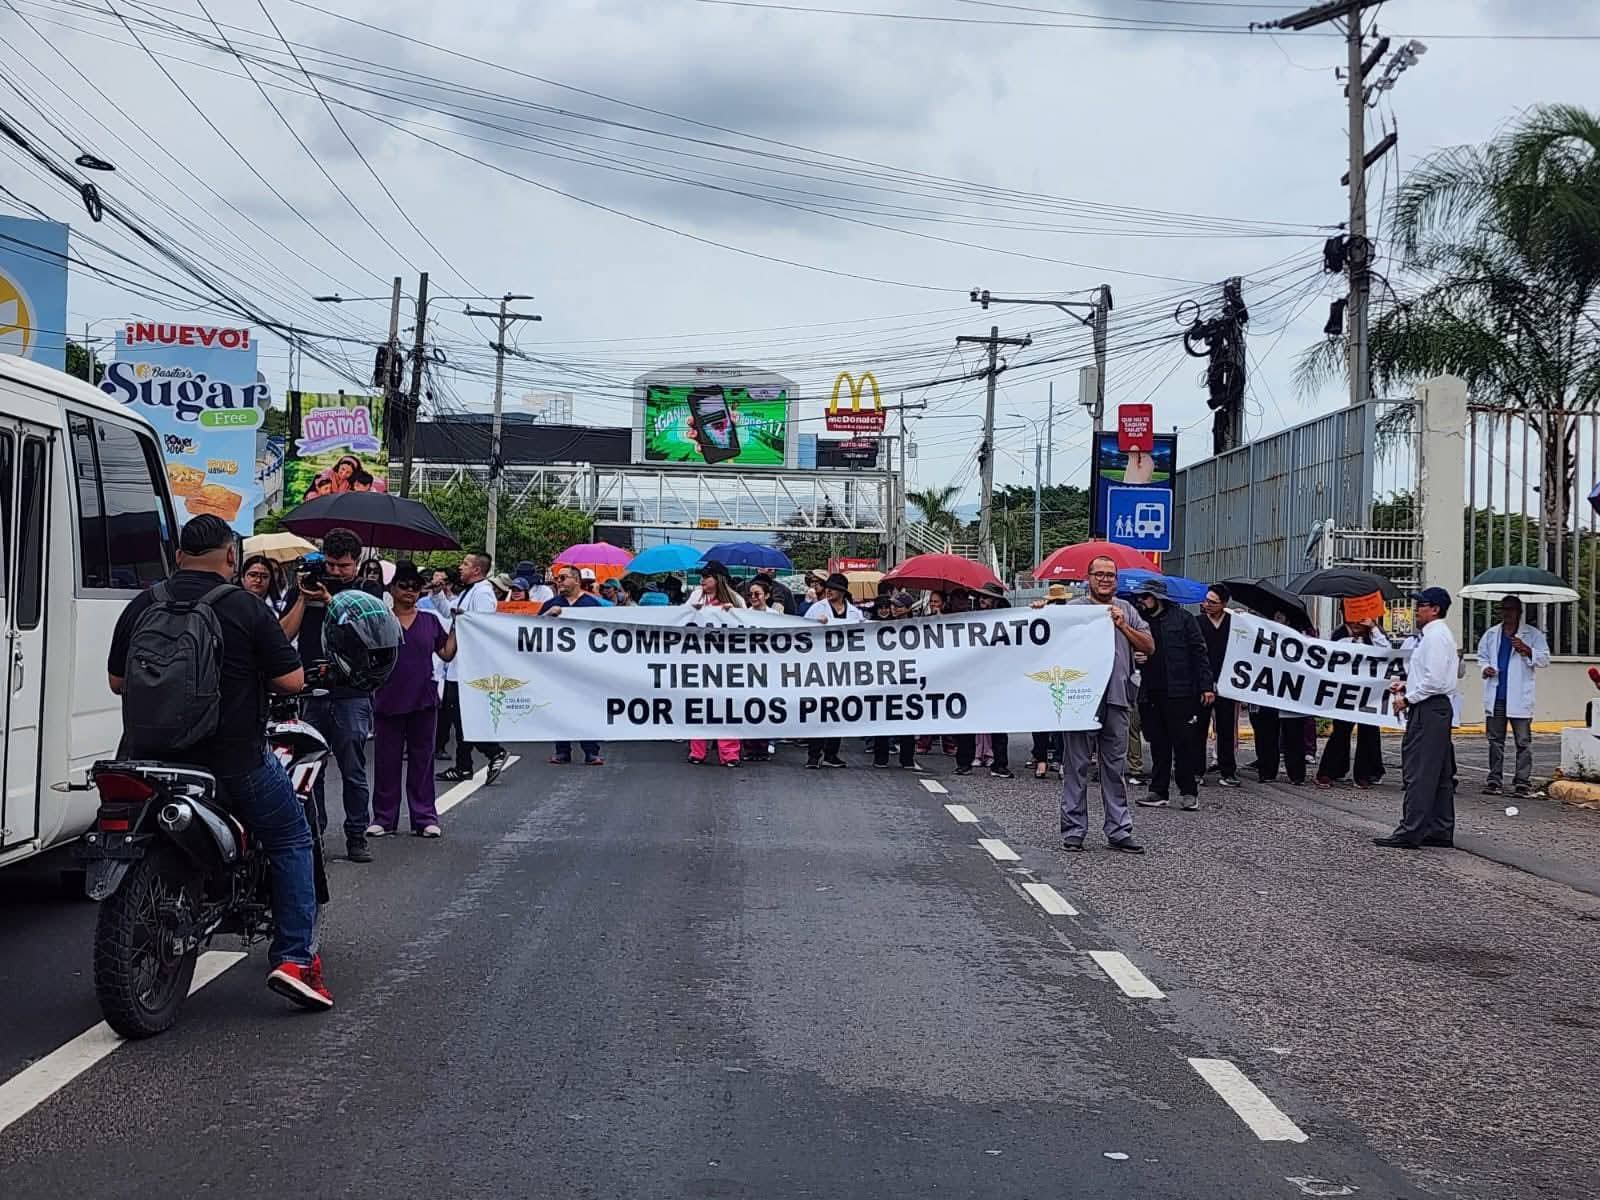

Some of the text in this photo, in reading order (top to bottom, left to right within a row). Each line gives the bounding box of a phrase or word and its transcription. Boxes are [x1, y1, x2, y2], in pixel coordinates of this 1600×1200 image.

[127, 323, 249, 349] ¡NUEVO!
[101, 362, 268, 422] Sugar
[214, 413, 248, 425] Free
[517, 618, 1051, 654] MIS COMPAÑEROS DE CONTRATO
[1253, 628, 1408, 682] HOSPITA
[647, 659, 928, 691] TIENEN HAMBRE,
[1230, 660, 1402, 718] SAN FELI
[606, 692, 968, 725] POR ELLOS PROTESTO
